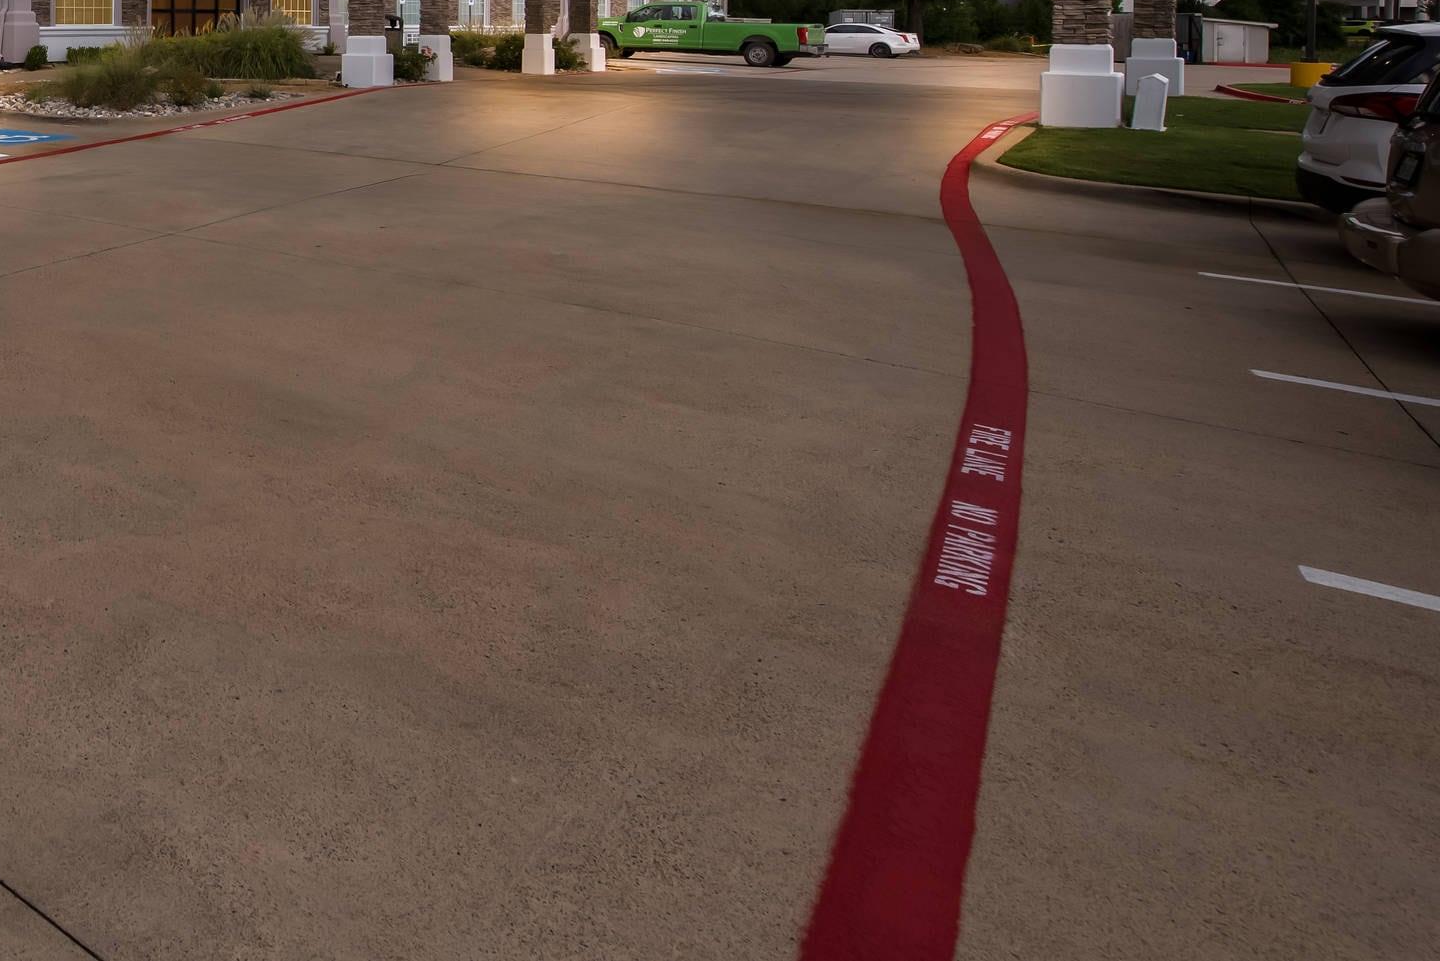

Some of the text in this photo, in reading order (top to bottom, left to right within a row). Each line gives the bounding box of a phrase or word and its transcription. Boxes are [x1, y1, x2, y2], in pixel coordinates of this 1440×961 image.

[961, 447, 1008, 482] LANE
[951, 499, 998, 526] NO
[934, 524, 996, 596] PARKING
